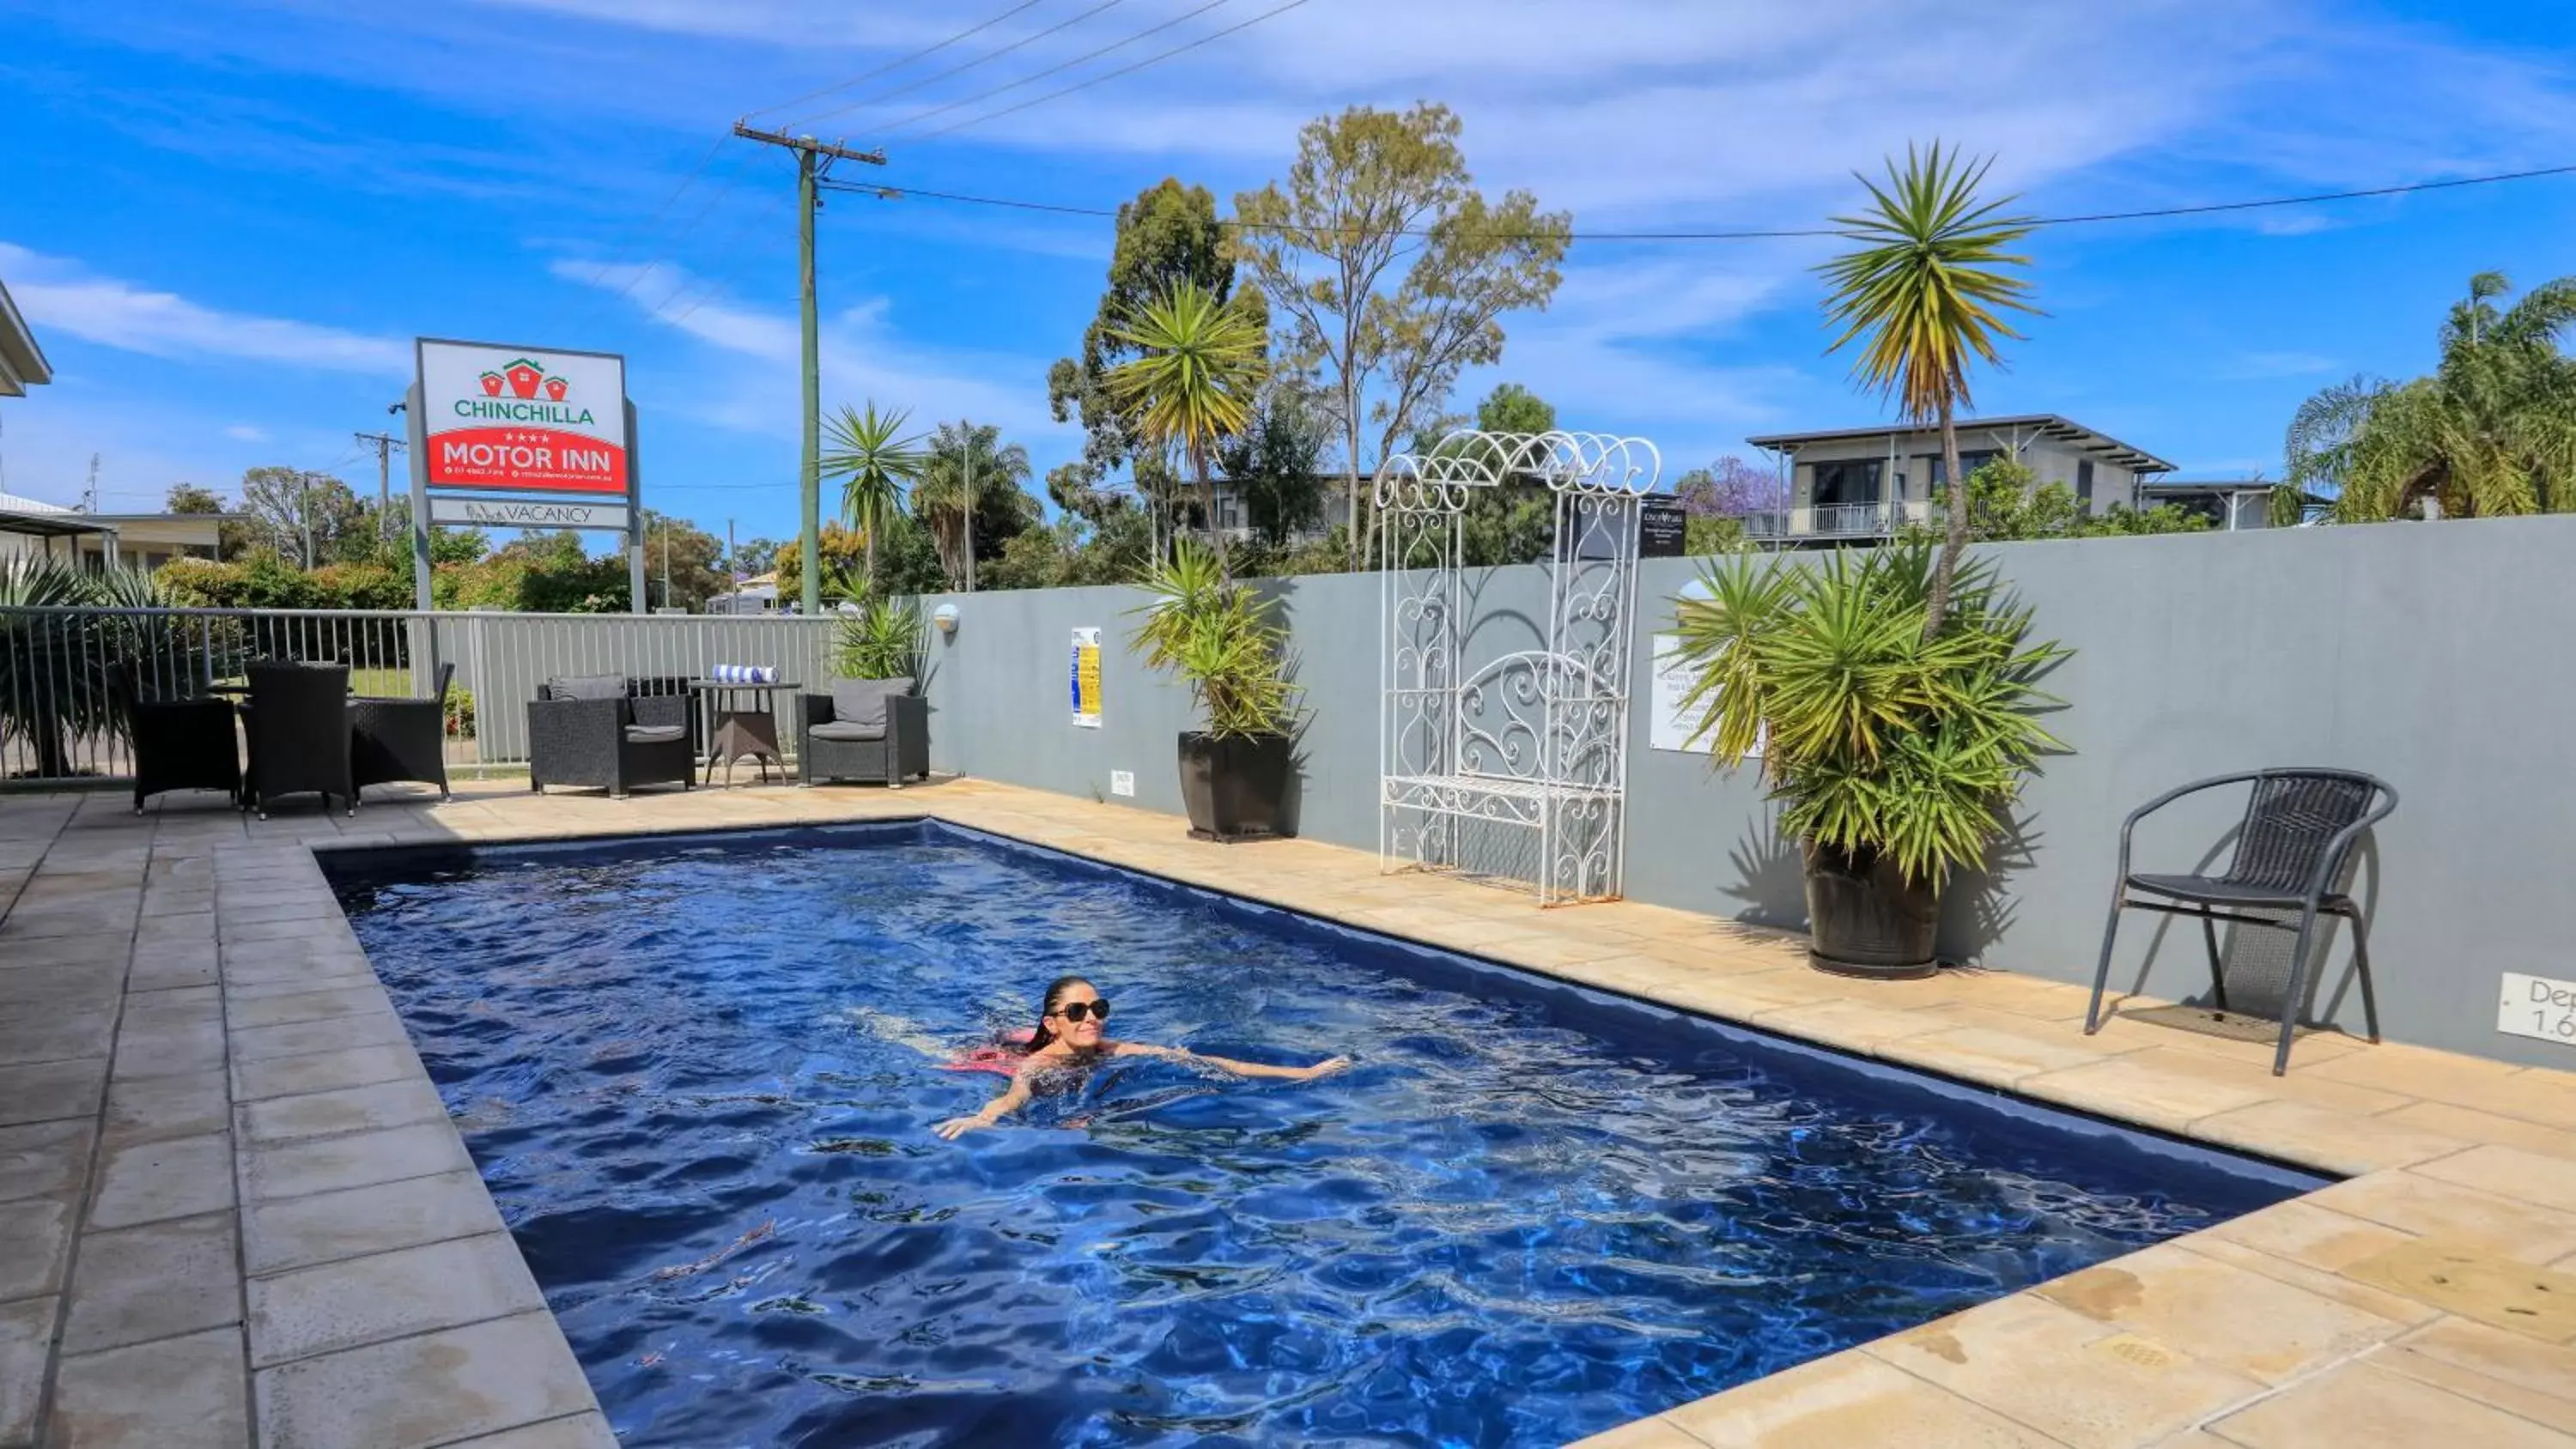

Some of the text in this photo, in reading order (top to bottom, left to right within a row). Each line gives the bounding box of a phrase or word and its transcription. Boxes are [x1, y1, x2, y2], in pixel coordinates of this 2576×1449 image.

[454, 399, 595, 426] CHINCHILLA
[443, 441, 611, 472] MOTOR INN
[504, 504, 592, 523] VACANCY
